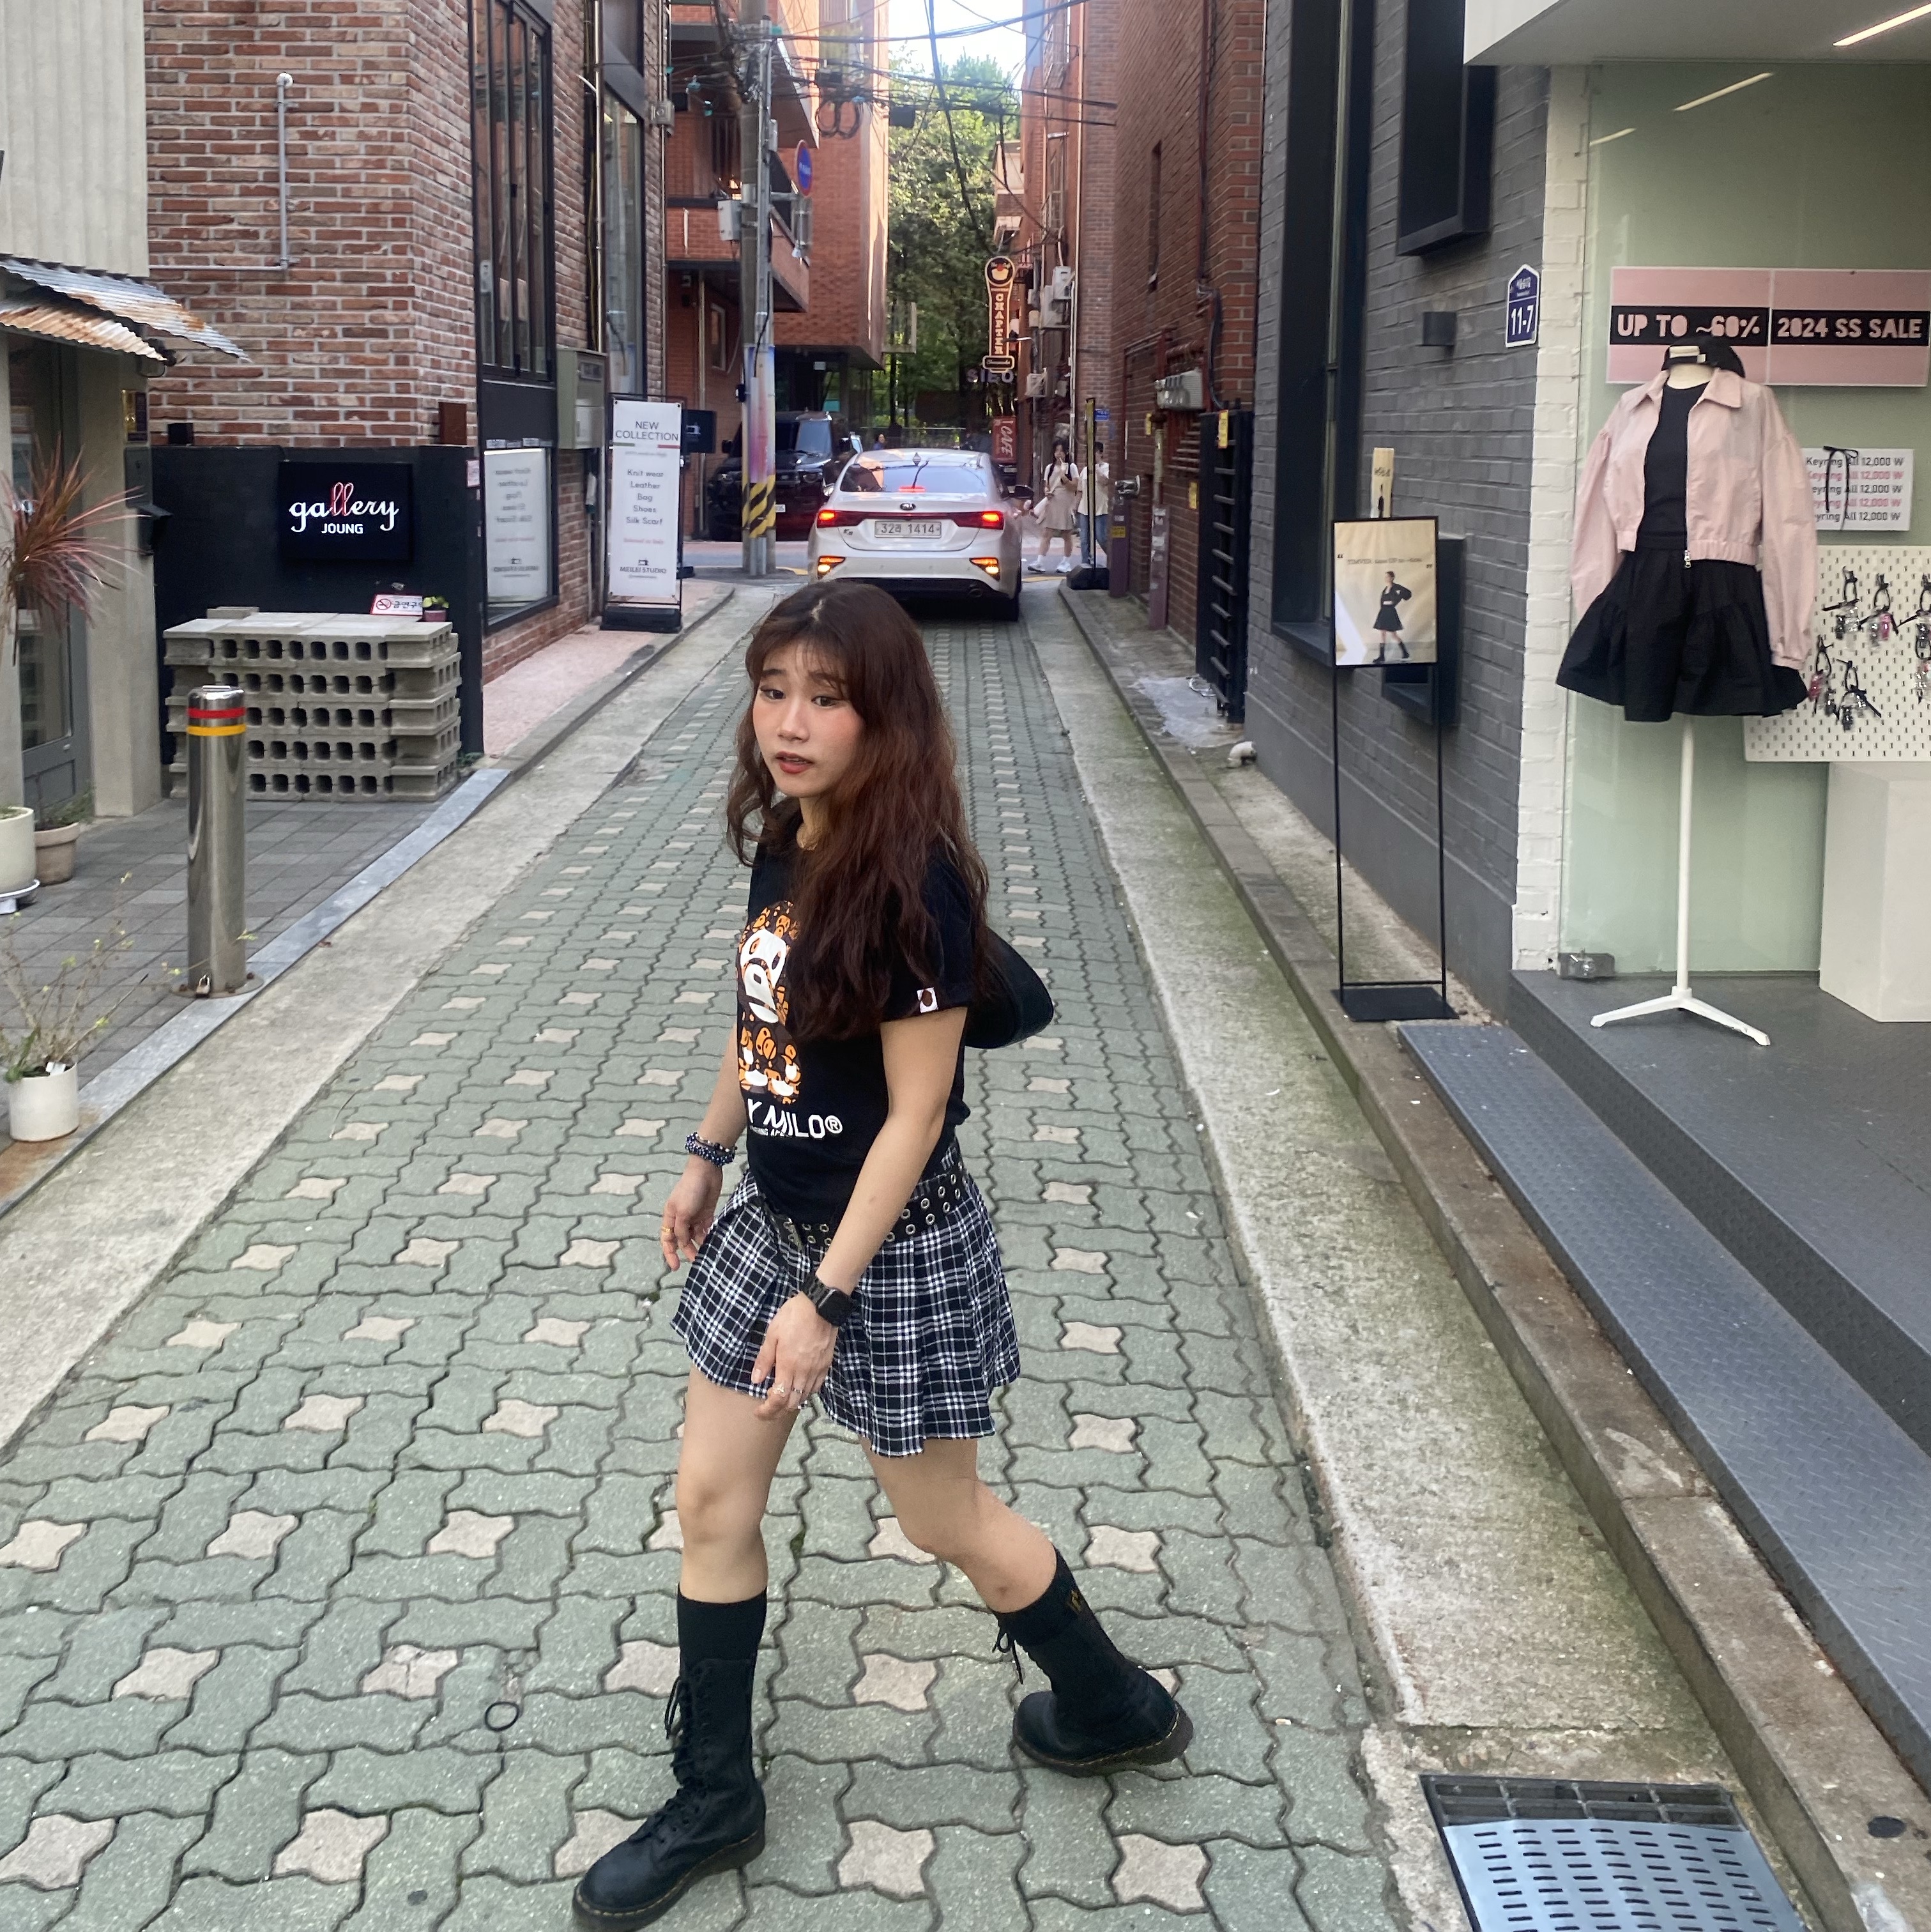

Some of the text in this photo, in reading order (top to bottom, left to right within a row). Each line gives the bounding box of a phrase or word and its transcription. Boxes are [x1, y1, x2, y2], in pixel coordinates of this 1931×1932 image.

[1511, 304, 1534, 335] 11-7
[1617, 314, 1923, 338] UP TO ~60% 2024 SS SALE
[635, 421, 659, 430] NEW
[615, 430, 679, 441] COLLECTION
[1000, 425, 1013, 457] CAFE
[1862, 457, 1891, 466] 12,000
[1861, 471, 1890, 480] 12,000
[1861, 484, 1889, 494] 12,000
[637, 493, 653, 502] Bag
[1859, 498, 1889, 507] 12,000
[289, 482, 400, 533] gallery
[1859, 512, 1889, 521] 12,000
[321, 523, 363, 534] JOUNG
[908, 523, 934, 533] 1414
